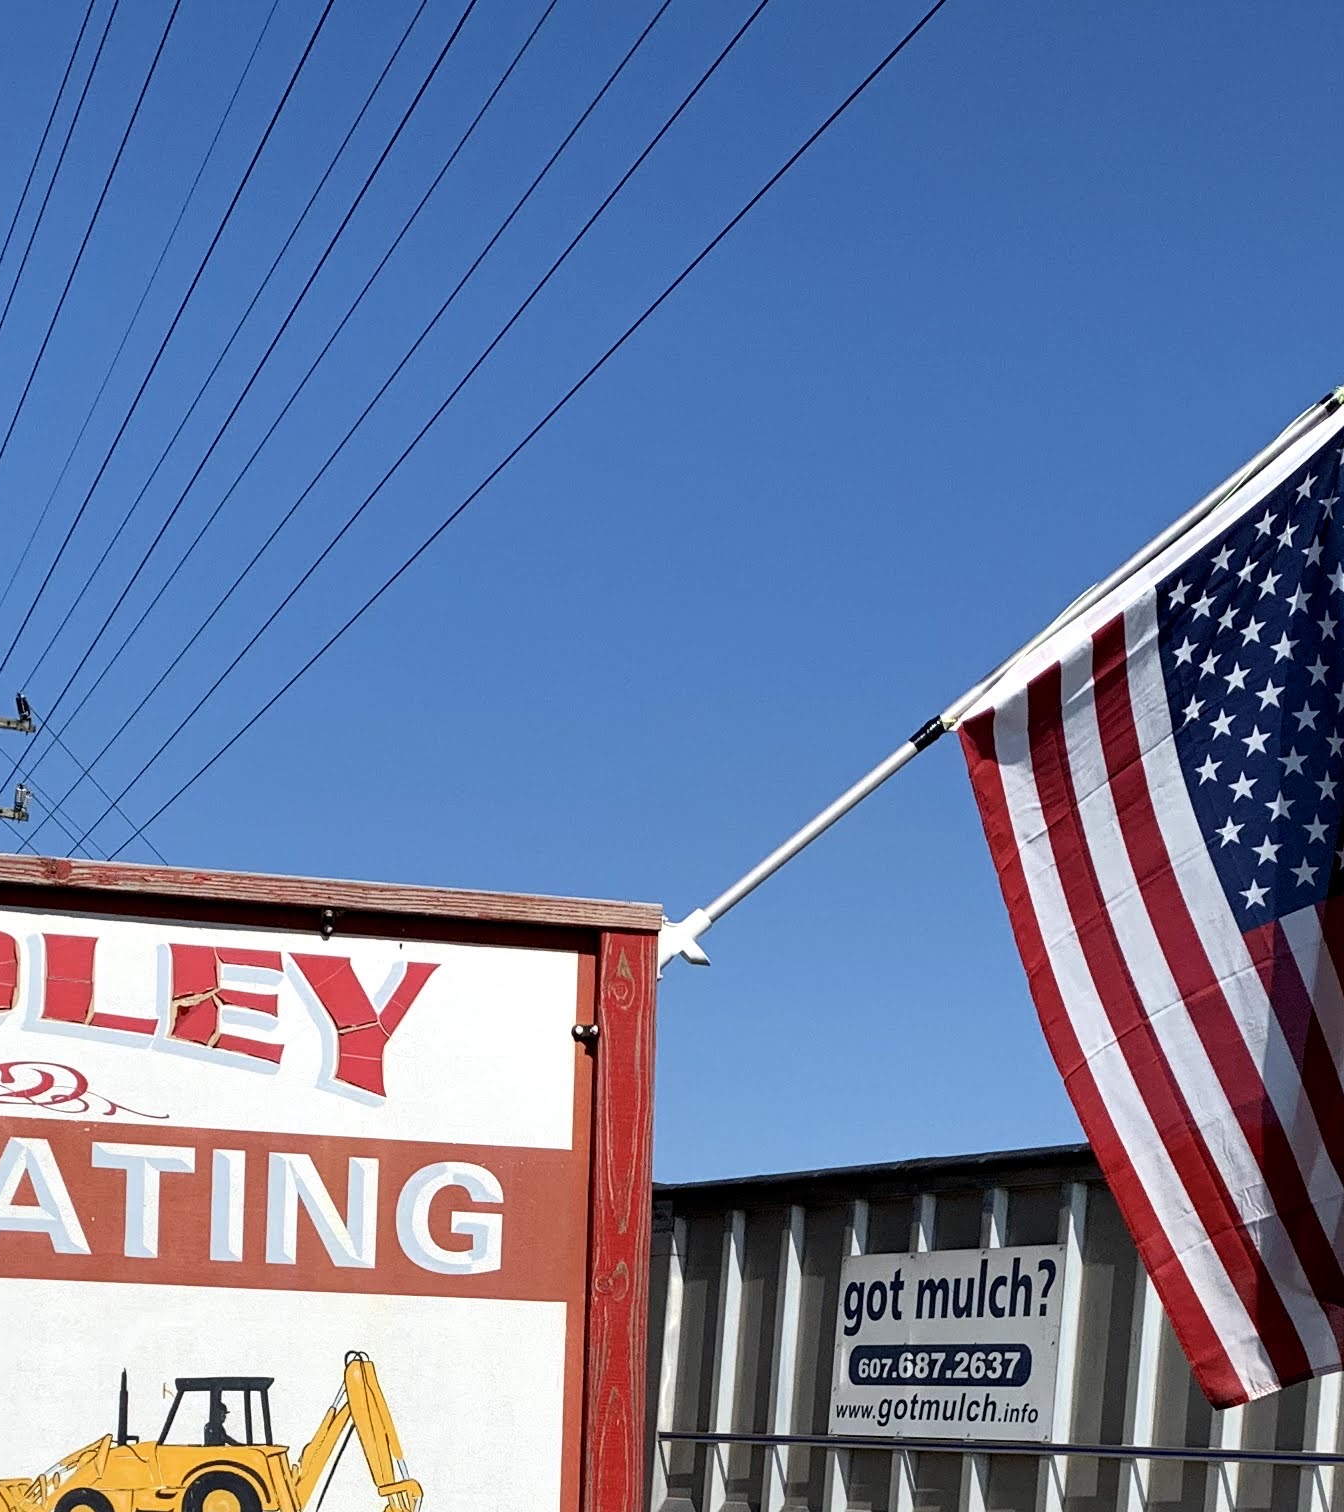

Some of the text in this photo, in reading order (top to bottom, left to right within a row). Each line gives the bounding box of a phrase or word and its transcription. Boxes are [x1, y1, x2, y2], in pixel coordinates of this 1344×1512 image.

[843, 1257, 1057, 1336] got mulch?
[857, 1351, 1022, 1380] 607.687.2637
[835, 1392, 1039, 1427] www.gotmulch.info
